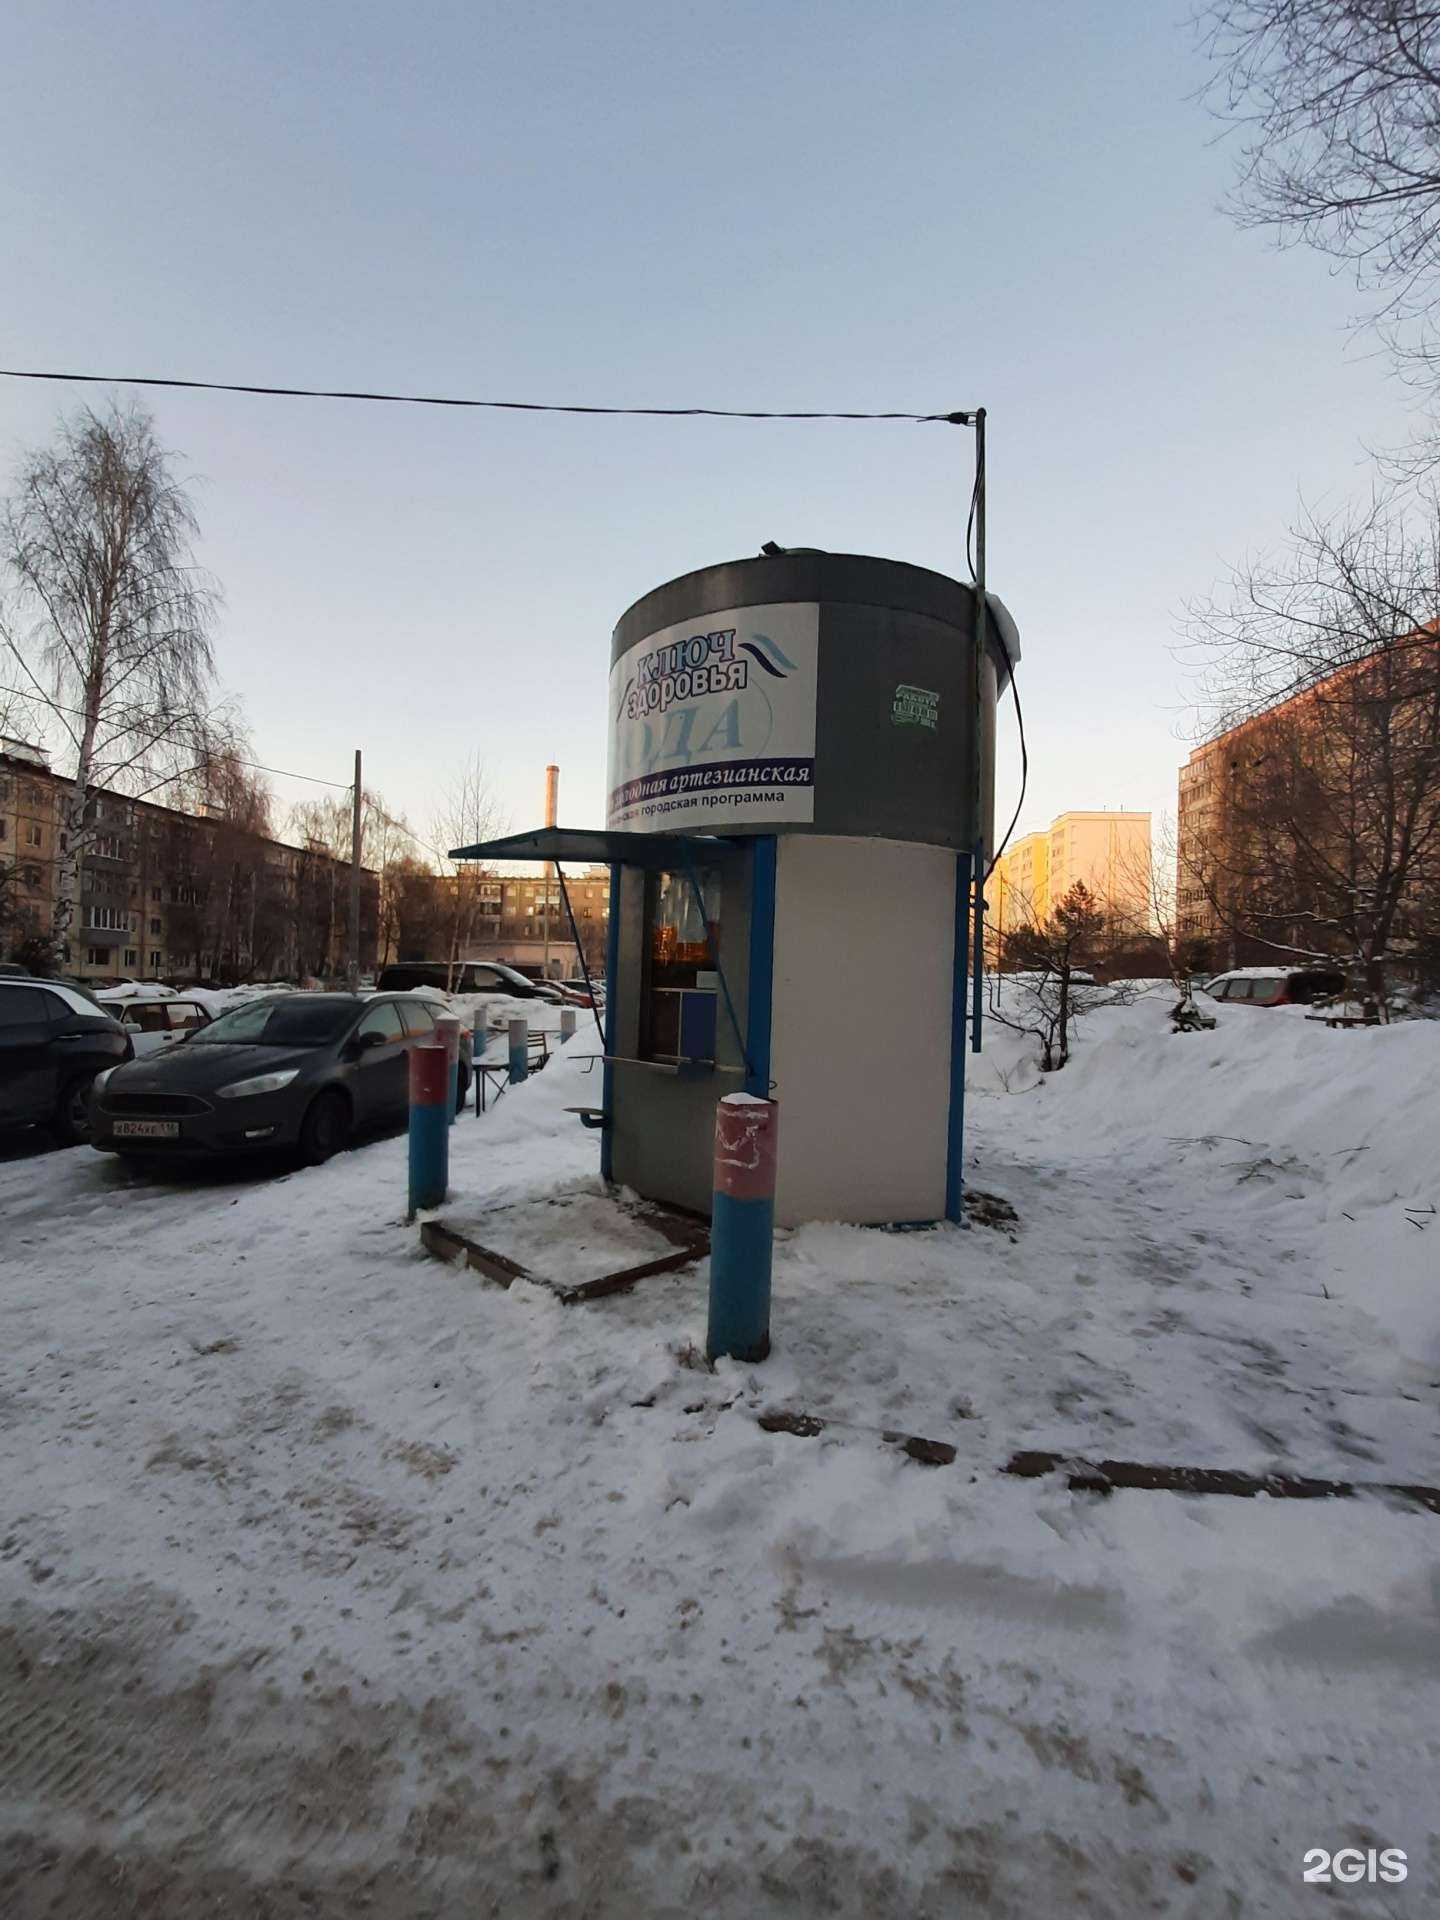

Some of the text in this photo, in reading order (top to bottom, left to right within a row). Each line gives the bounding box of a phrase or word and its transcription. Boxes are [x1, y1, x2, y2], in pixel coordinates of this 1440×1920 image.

[637, 628, 737, 684] КЛЮЧ
[669, 765, 811, 795] артезианская
[641, 799, 698, 818] городская
[701, 791, 785, 810] программа
